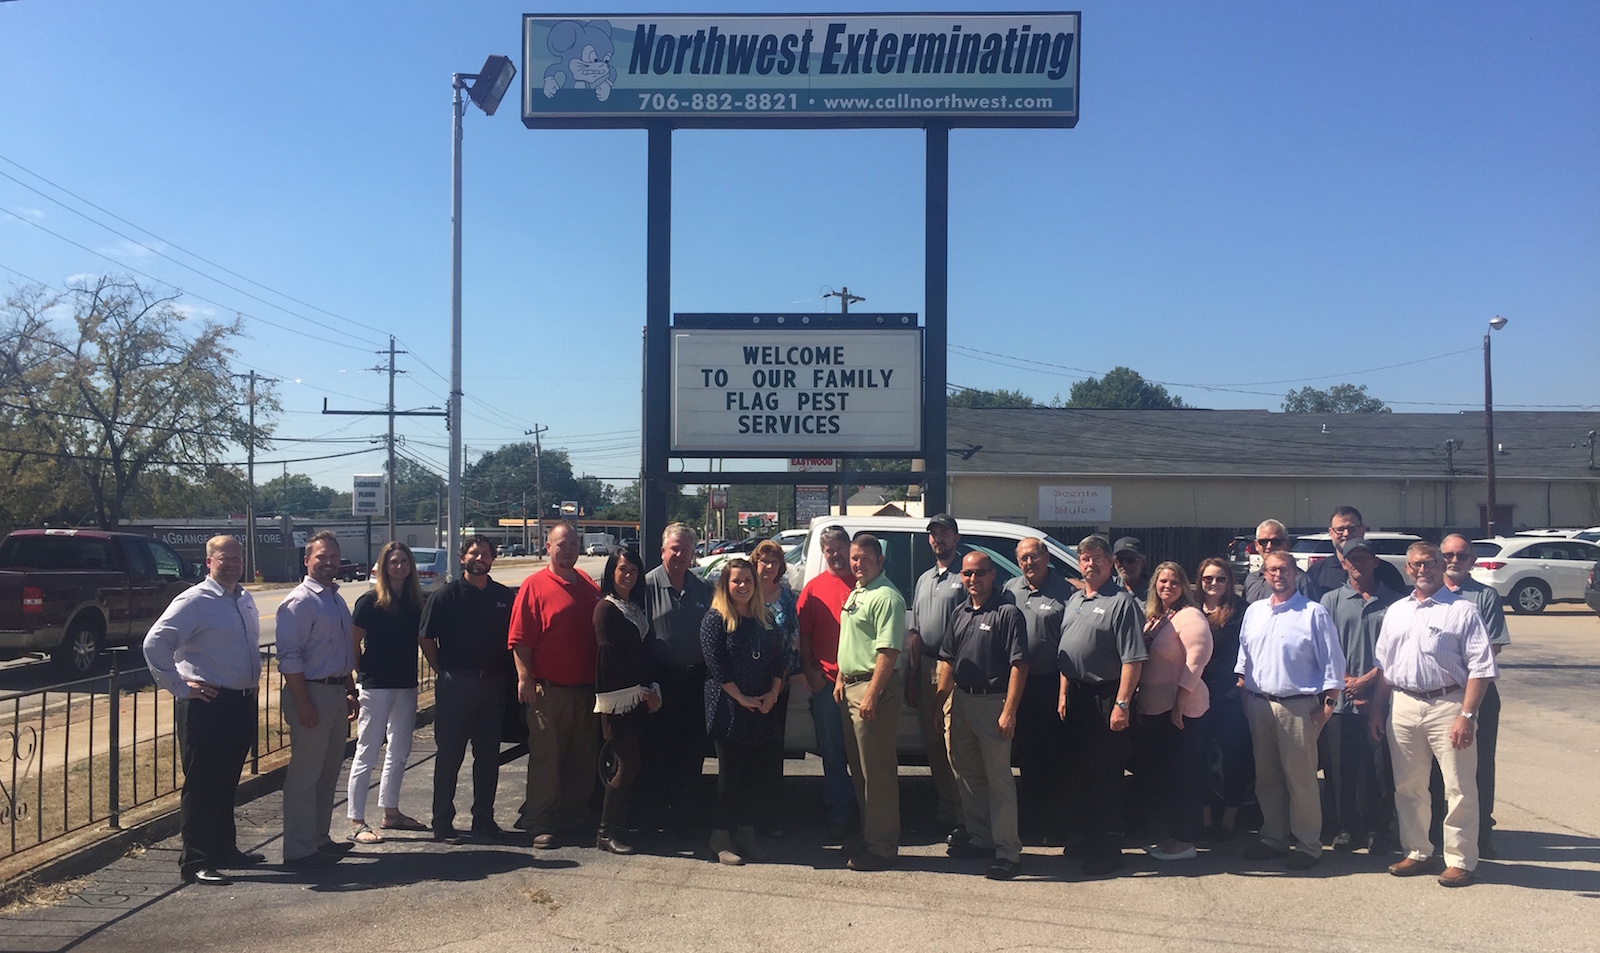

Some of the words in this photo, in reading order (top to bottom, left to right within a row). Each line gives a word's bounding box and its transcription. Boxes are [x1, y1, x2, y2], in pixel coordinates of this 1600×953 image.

[628, 23, 814, 76] Northwest
[819, 23, 1074, 81] Exterminating
[638, 93, 798, 111] 706-882-8821
[824, 93, 1053, 110] www.callnorthwest.com
[743, 346, 845, 366] WELCOME
[701, 369, 729, 388] TO
[752, 369, 797, 388] OUR
[813, 369, 894, 388] FAMILY
[726, 392, 779, 411] FLAG
[797, 392, 849, 411] PEST
[738, 415, 841, 434] SERVICES
[791, 458, 833, 466] EASTWOOD
[257, 534, 281, 544] TORE
